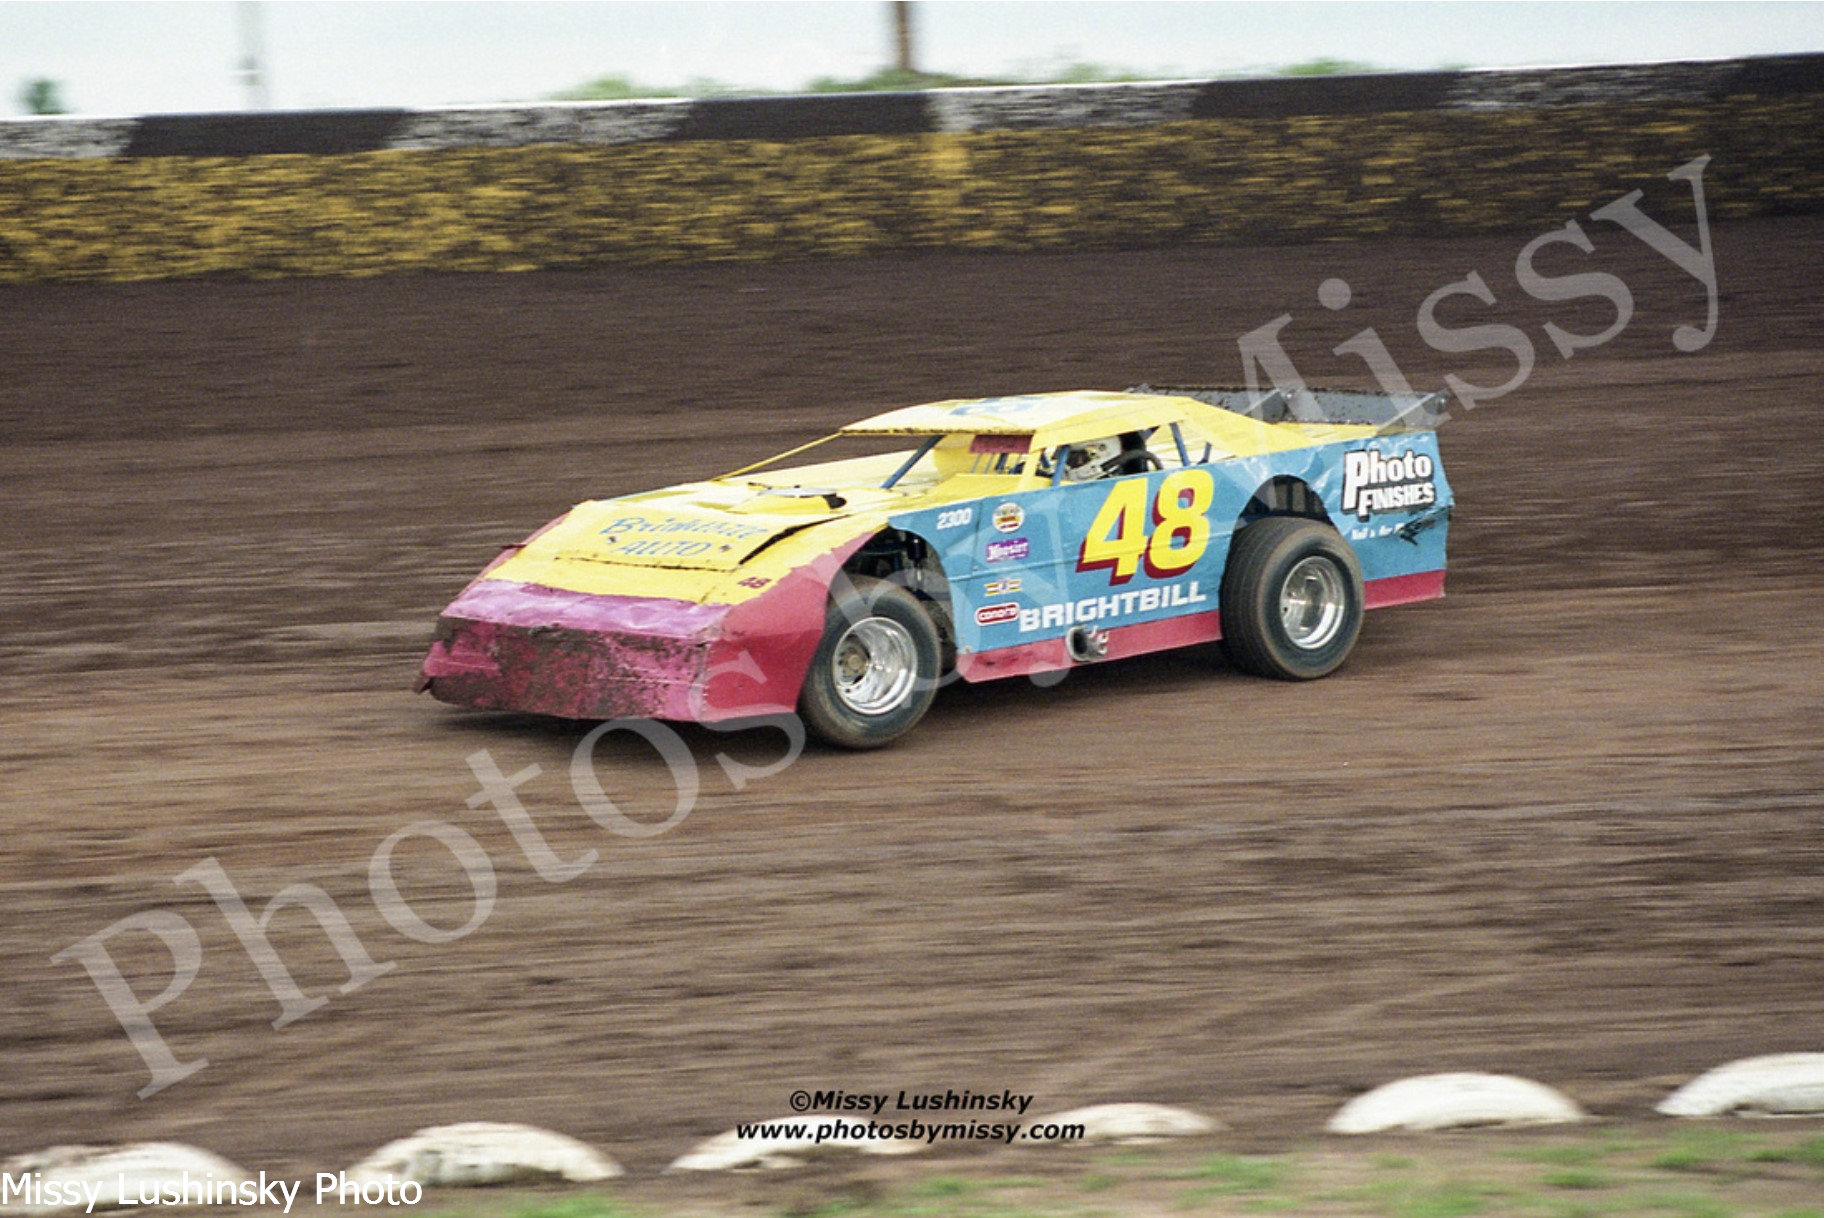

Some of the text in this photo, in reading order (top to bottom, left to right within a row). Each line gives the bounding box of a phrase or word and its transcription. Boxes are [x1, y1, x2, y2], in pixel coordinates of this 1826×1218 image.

[1342, 449, 1433, 511] Photo
[1358, 482, 1435, 517] FINISHES
[936, 507, 972, 530] 2300
[1076, 469, 1214, 586] 48
[617, 540, 711, 556] AUTO
[738, 577, 772, 589] 48
[1018, 581, 1207, 633] BRIGHTBILL
